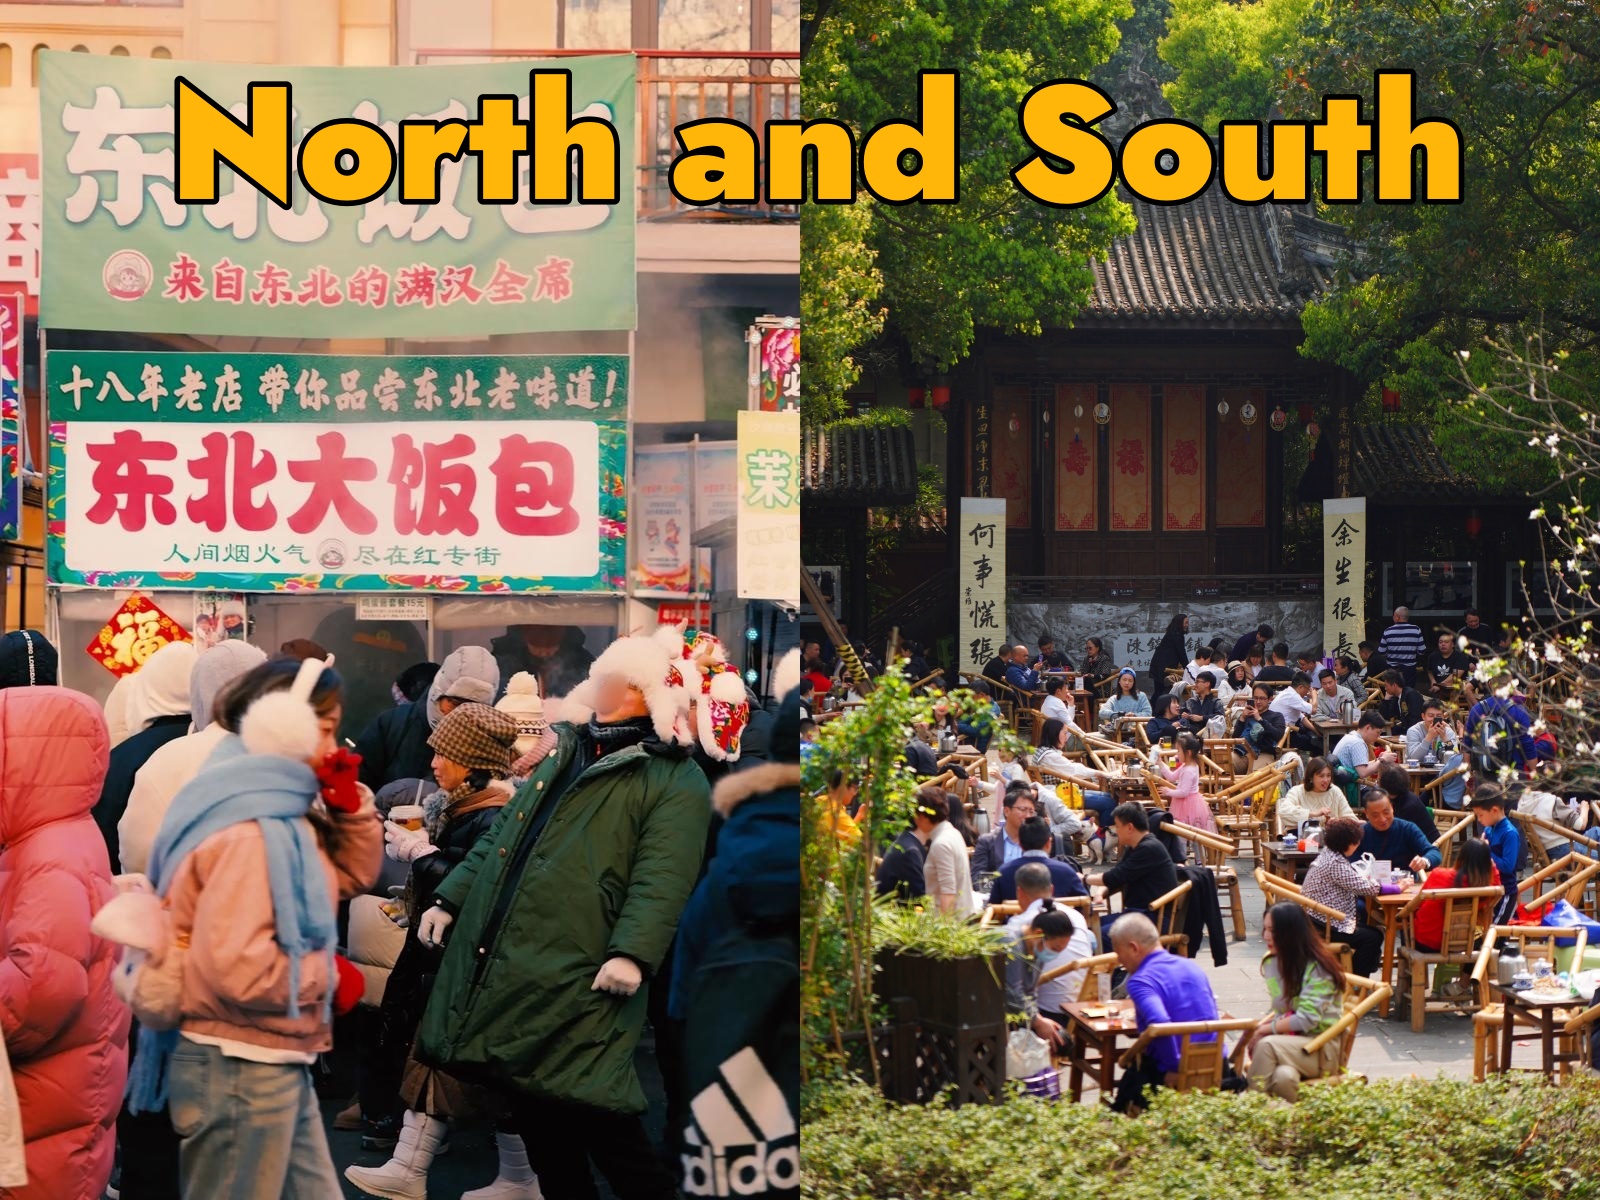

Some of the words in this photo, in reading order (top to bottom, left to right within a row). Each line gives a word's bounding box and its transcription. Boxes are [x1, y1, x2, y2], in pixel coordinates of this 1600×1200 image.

[163, 252, 574, 310] 来自东北的满汉全席
[60, 363, 243, 413] 十八年老店
[258, 363, 618, 413] 带你品尝东北老味道!
[86, 429, 578, 537] 东北大饭包
[746, 449, 800, 509] 茉
[163, 543, 311, 565] 人间烟火气
[353, 545, 502, 566] 尽在红专街
[110, 609, 169, 667] 福
